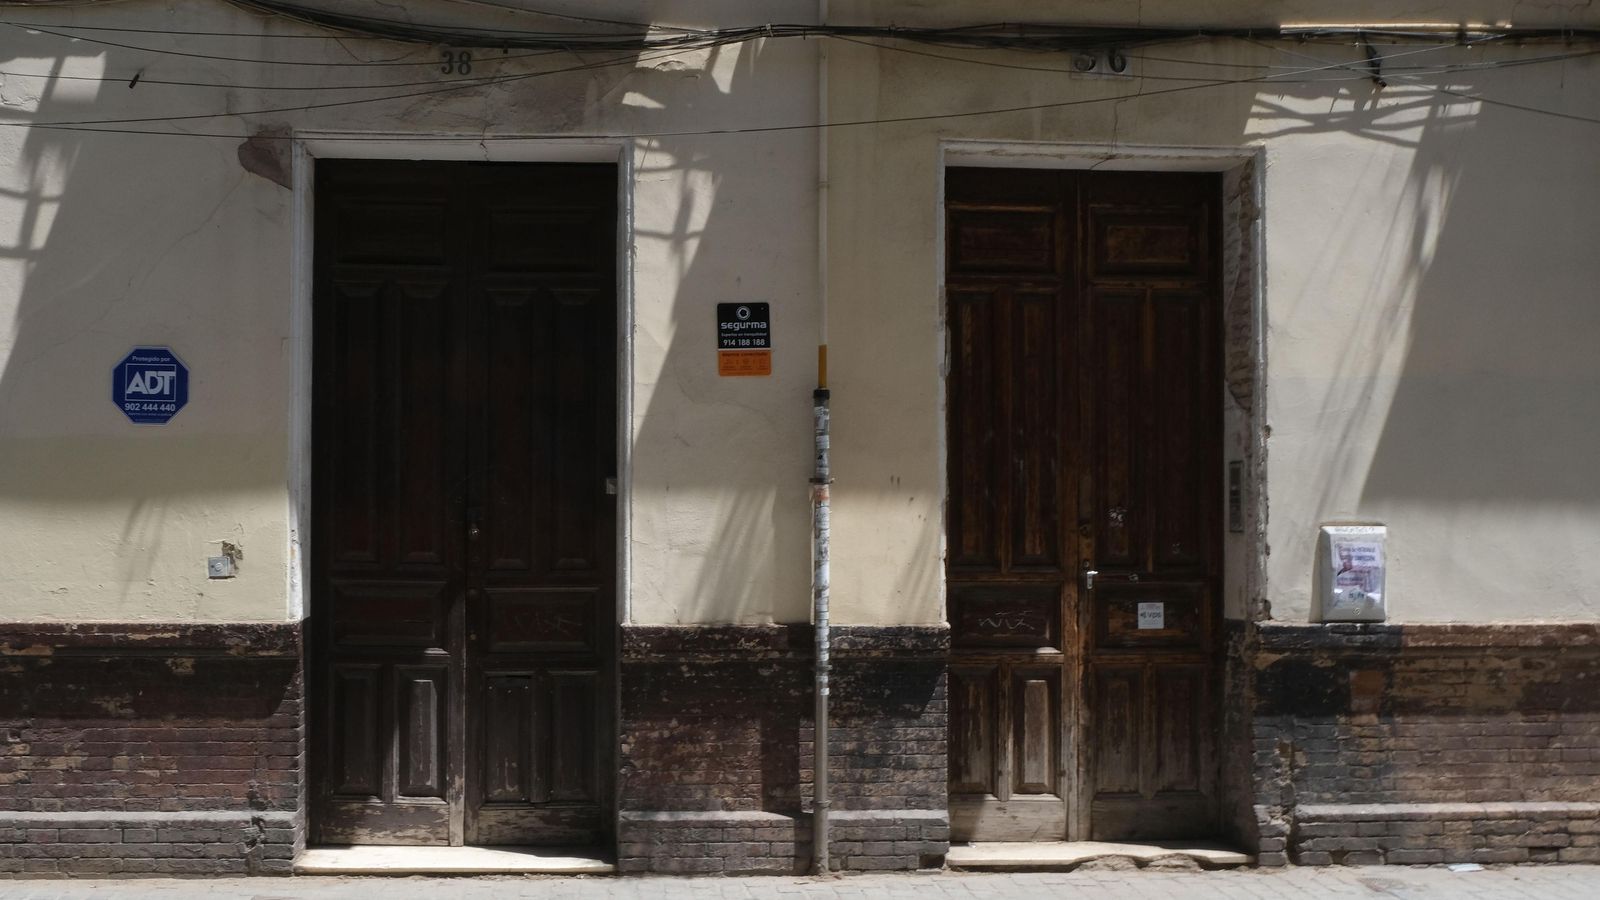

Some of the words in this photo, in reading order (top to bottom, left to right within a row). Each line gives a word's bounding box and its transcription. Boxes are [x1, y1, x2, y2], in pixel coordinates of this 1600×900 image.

[441, 51, 471, 75] 38
[721, 321, 767, 331] segurma
[753, 338, 766, 346] 188
[126, 370, 176, 395] ADT
[125, 403, 141, 411] 902
[142, 403, 158, 411] 444
[160, 403, 176, 412] 440
